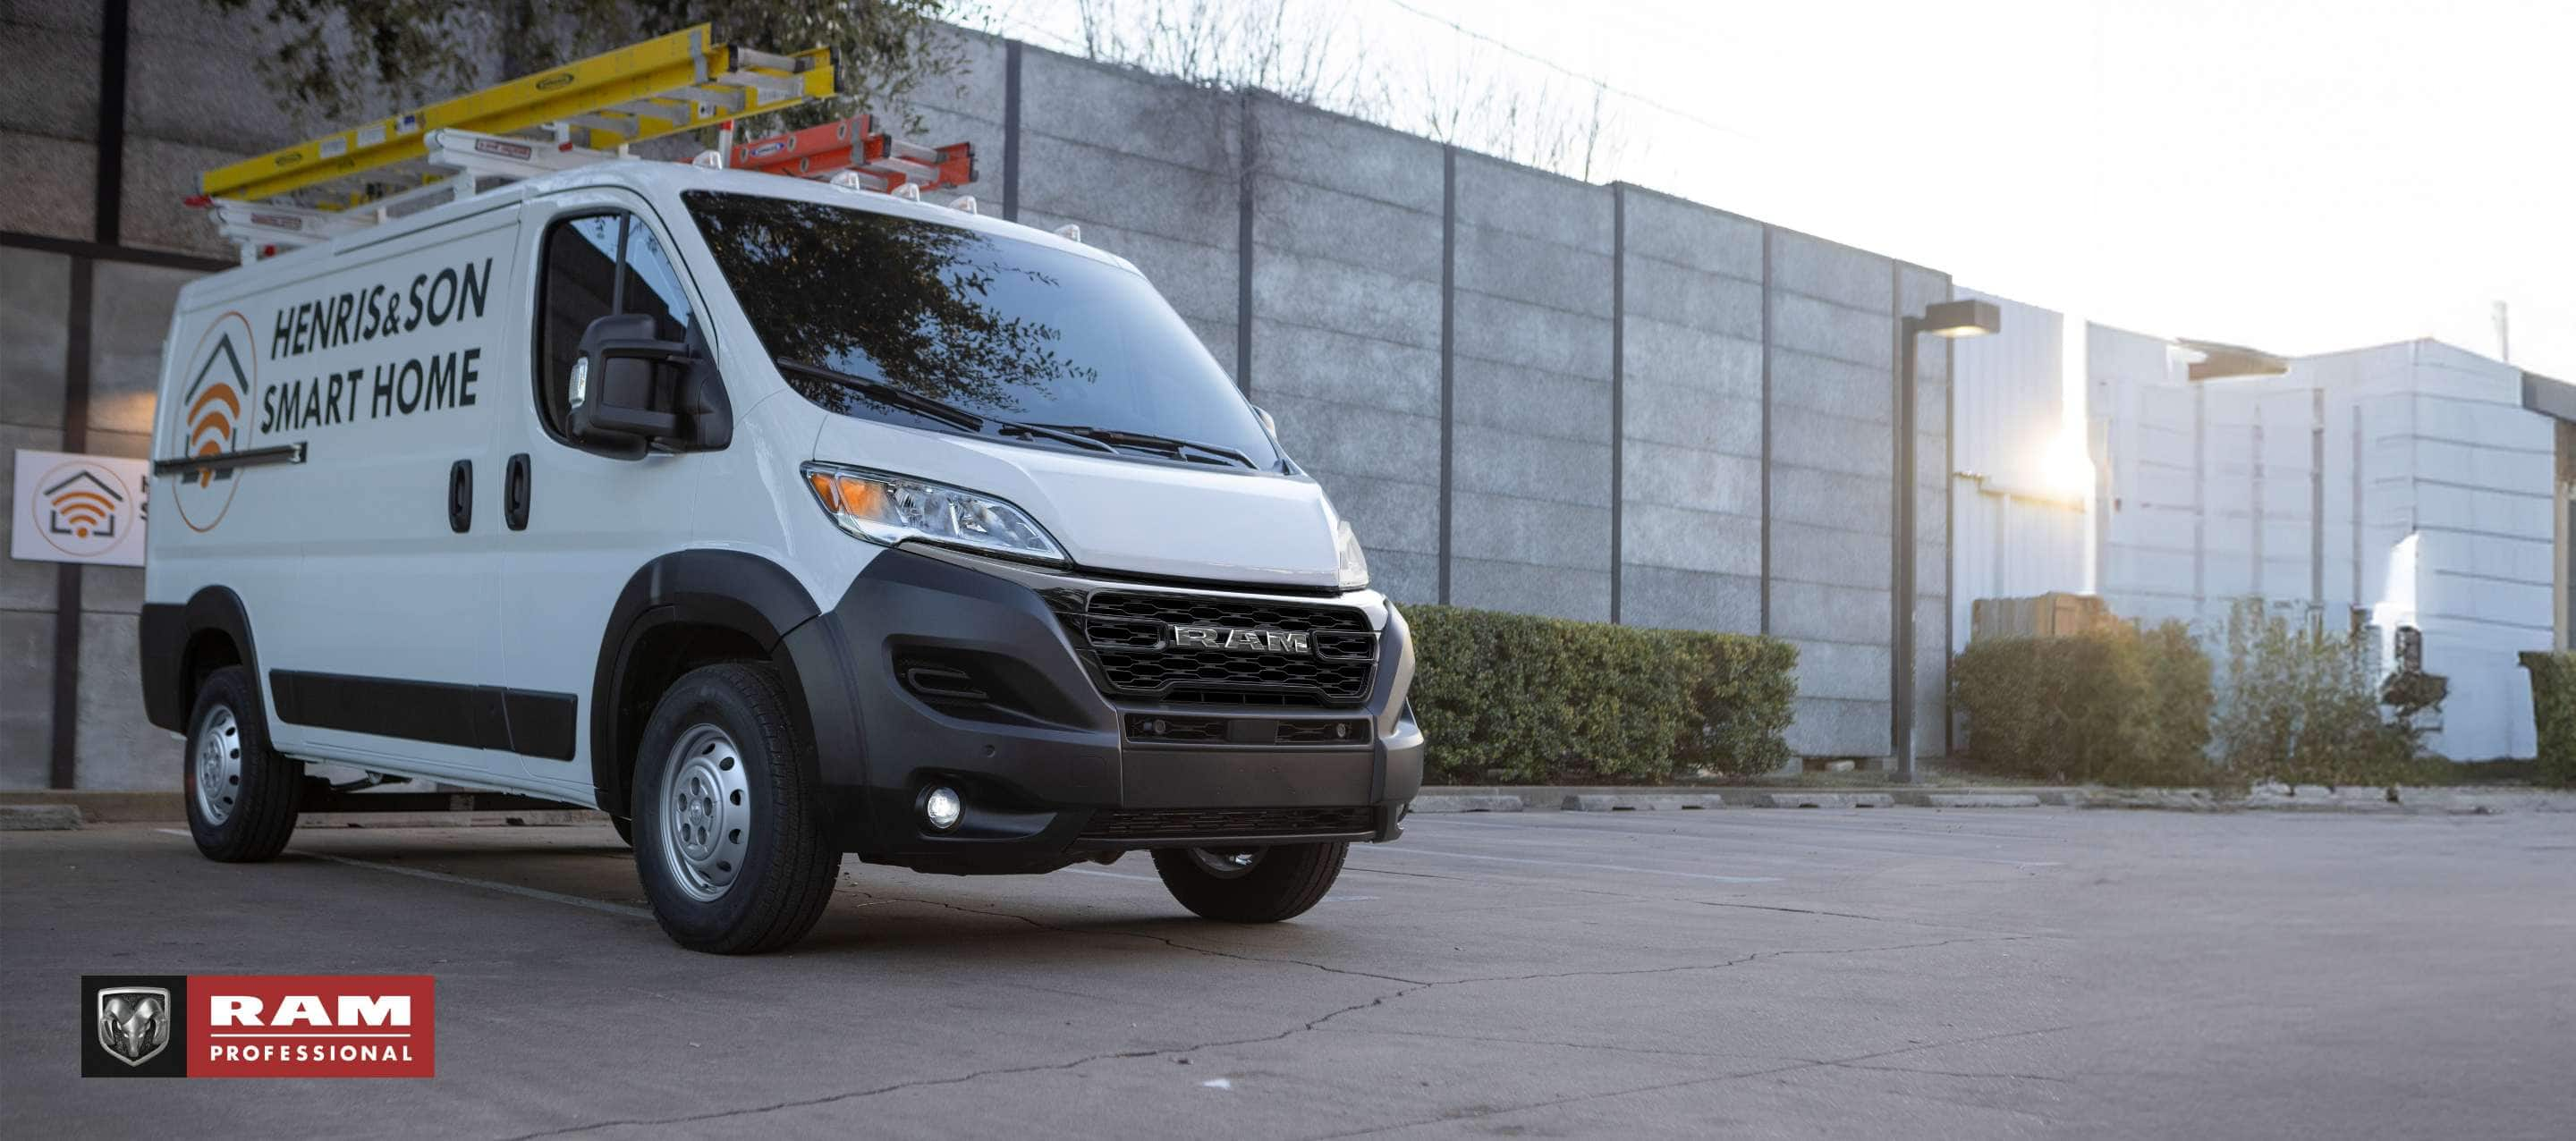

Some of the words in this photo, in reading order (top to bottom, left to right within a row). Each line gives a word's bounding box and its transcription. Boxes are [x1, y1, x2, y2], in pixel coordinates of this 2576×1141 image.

[271, 257, 493, 360] HENRIS&SON
[260, 368, 364, 434] SMART
[371, 347, 481, 418] HOME
[1174, 626, 1309, 653] RAM
